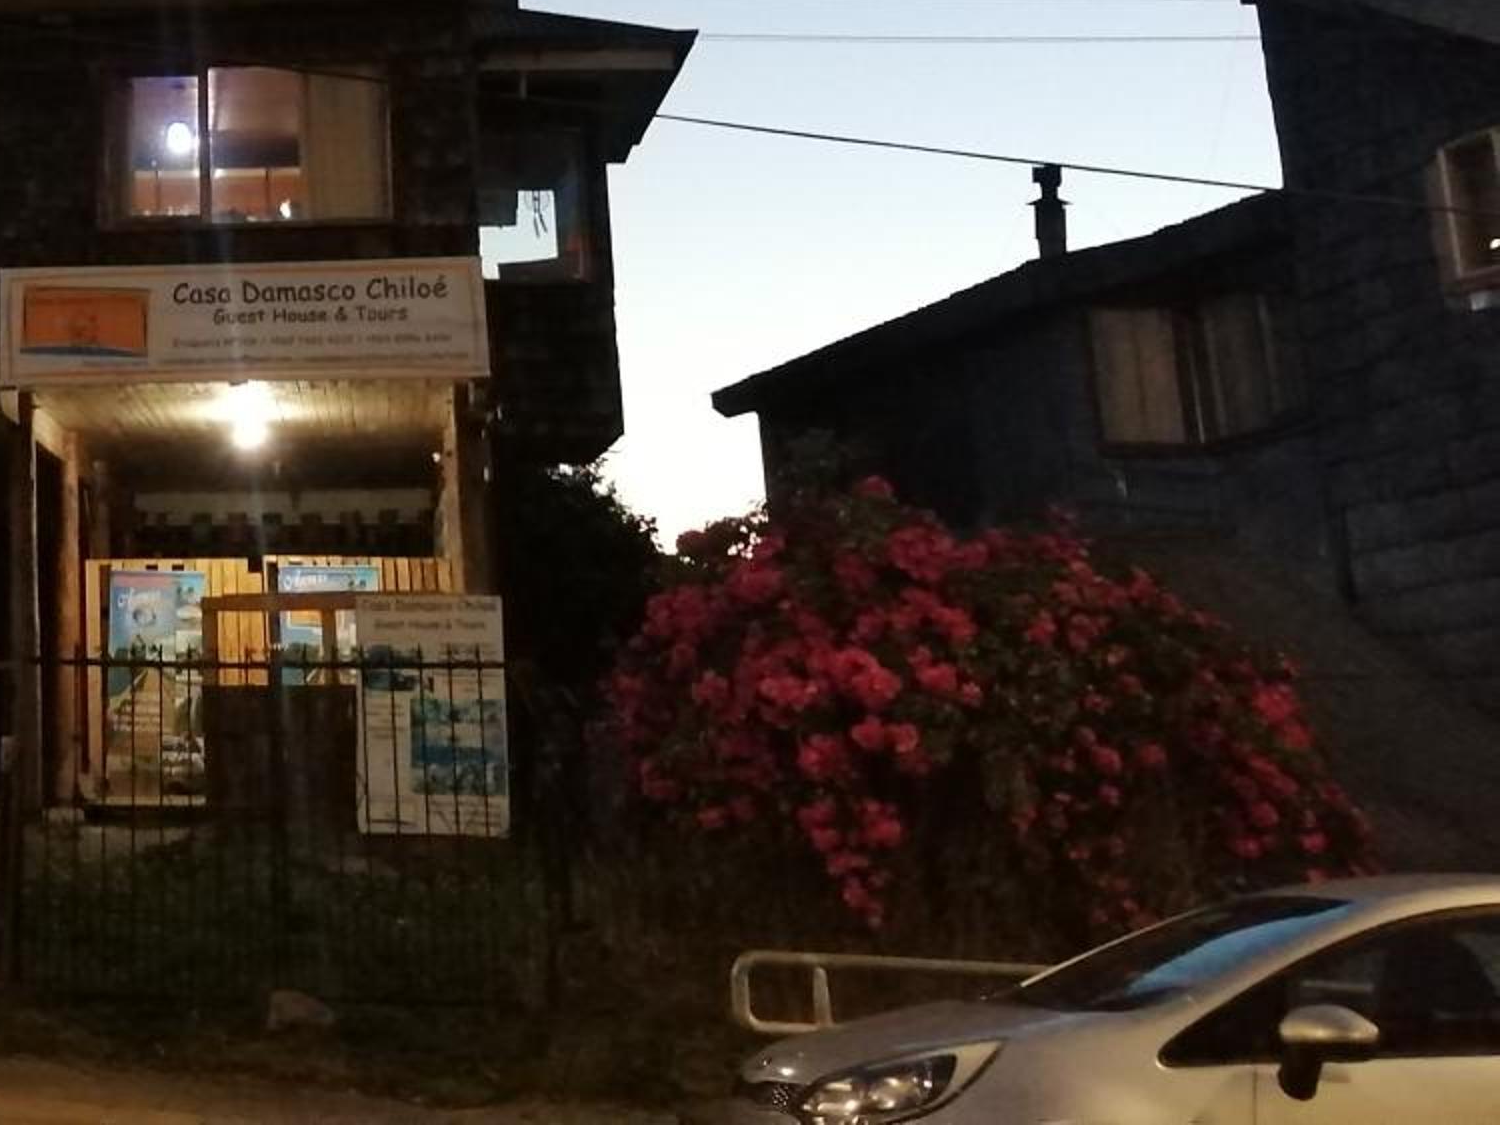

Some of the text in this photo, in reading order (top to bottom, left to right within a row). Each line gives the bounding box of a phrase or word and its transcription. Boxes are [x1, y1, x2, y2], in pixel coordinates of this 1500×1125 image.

[173, 275, 448, 304] Casa Damasco Chiloé
[213, 305, 409, 325] Guest House & Tours
